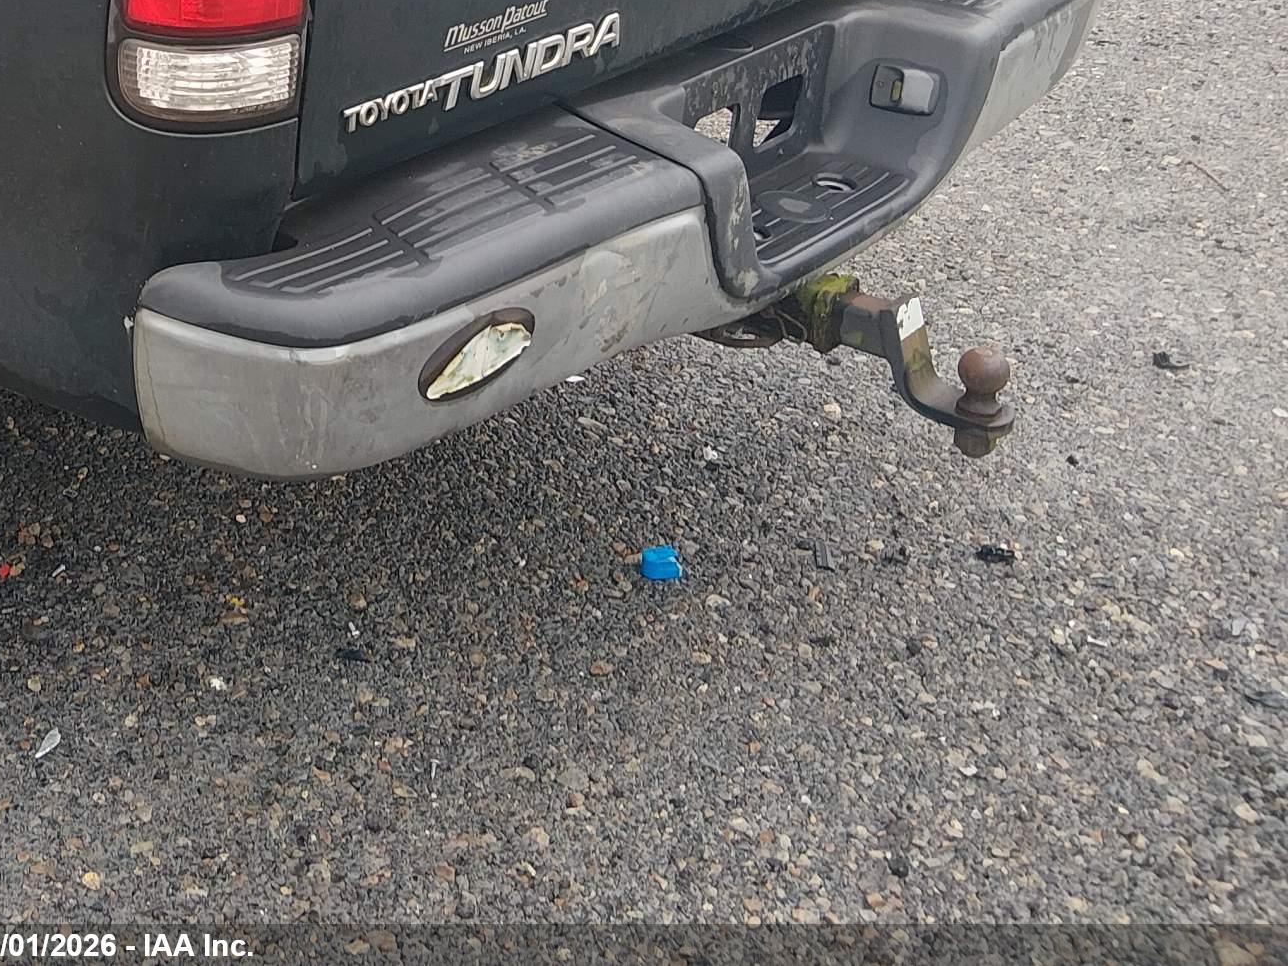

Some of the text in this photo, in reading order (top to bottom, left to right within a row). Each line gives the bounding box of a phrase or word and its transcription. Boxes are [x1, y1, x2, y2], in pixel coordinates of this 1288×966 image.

[444, 15, 503, 48] Musson
[463, 41, 484, 55] NEW
[343, 12, 620, 133] TOYOTA TUNDRA
